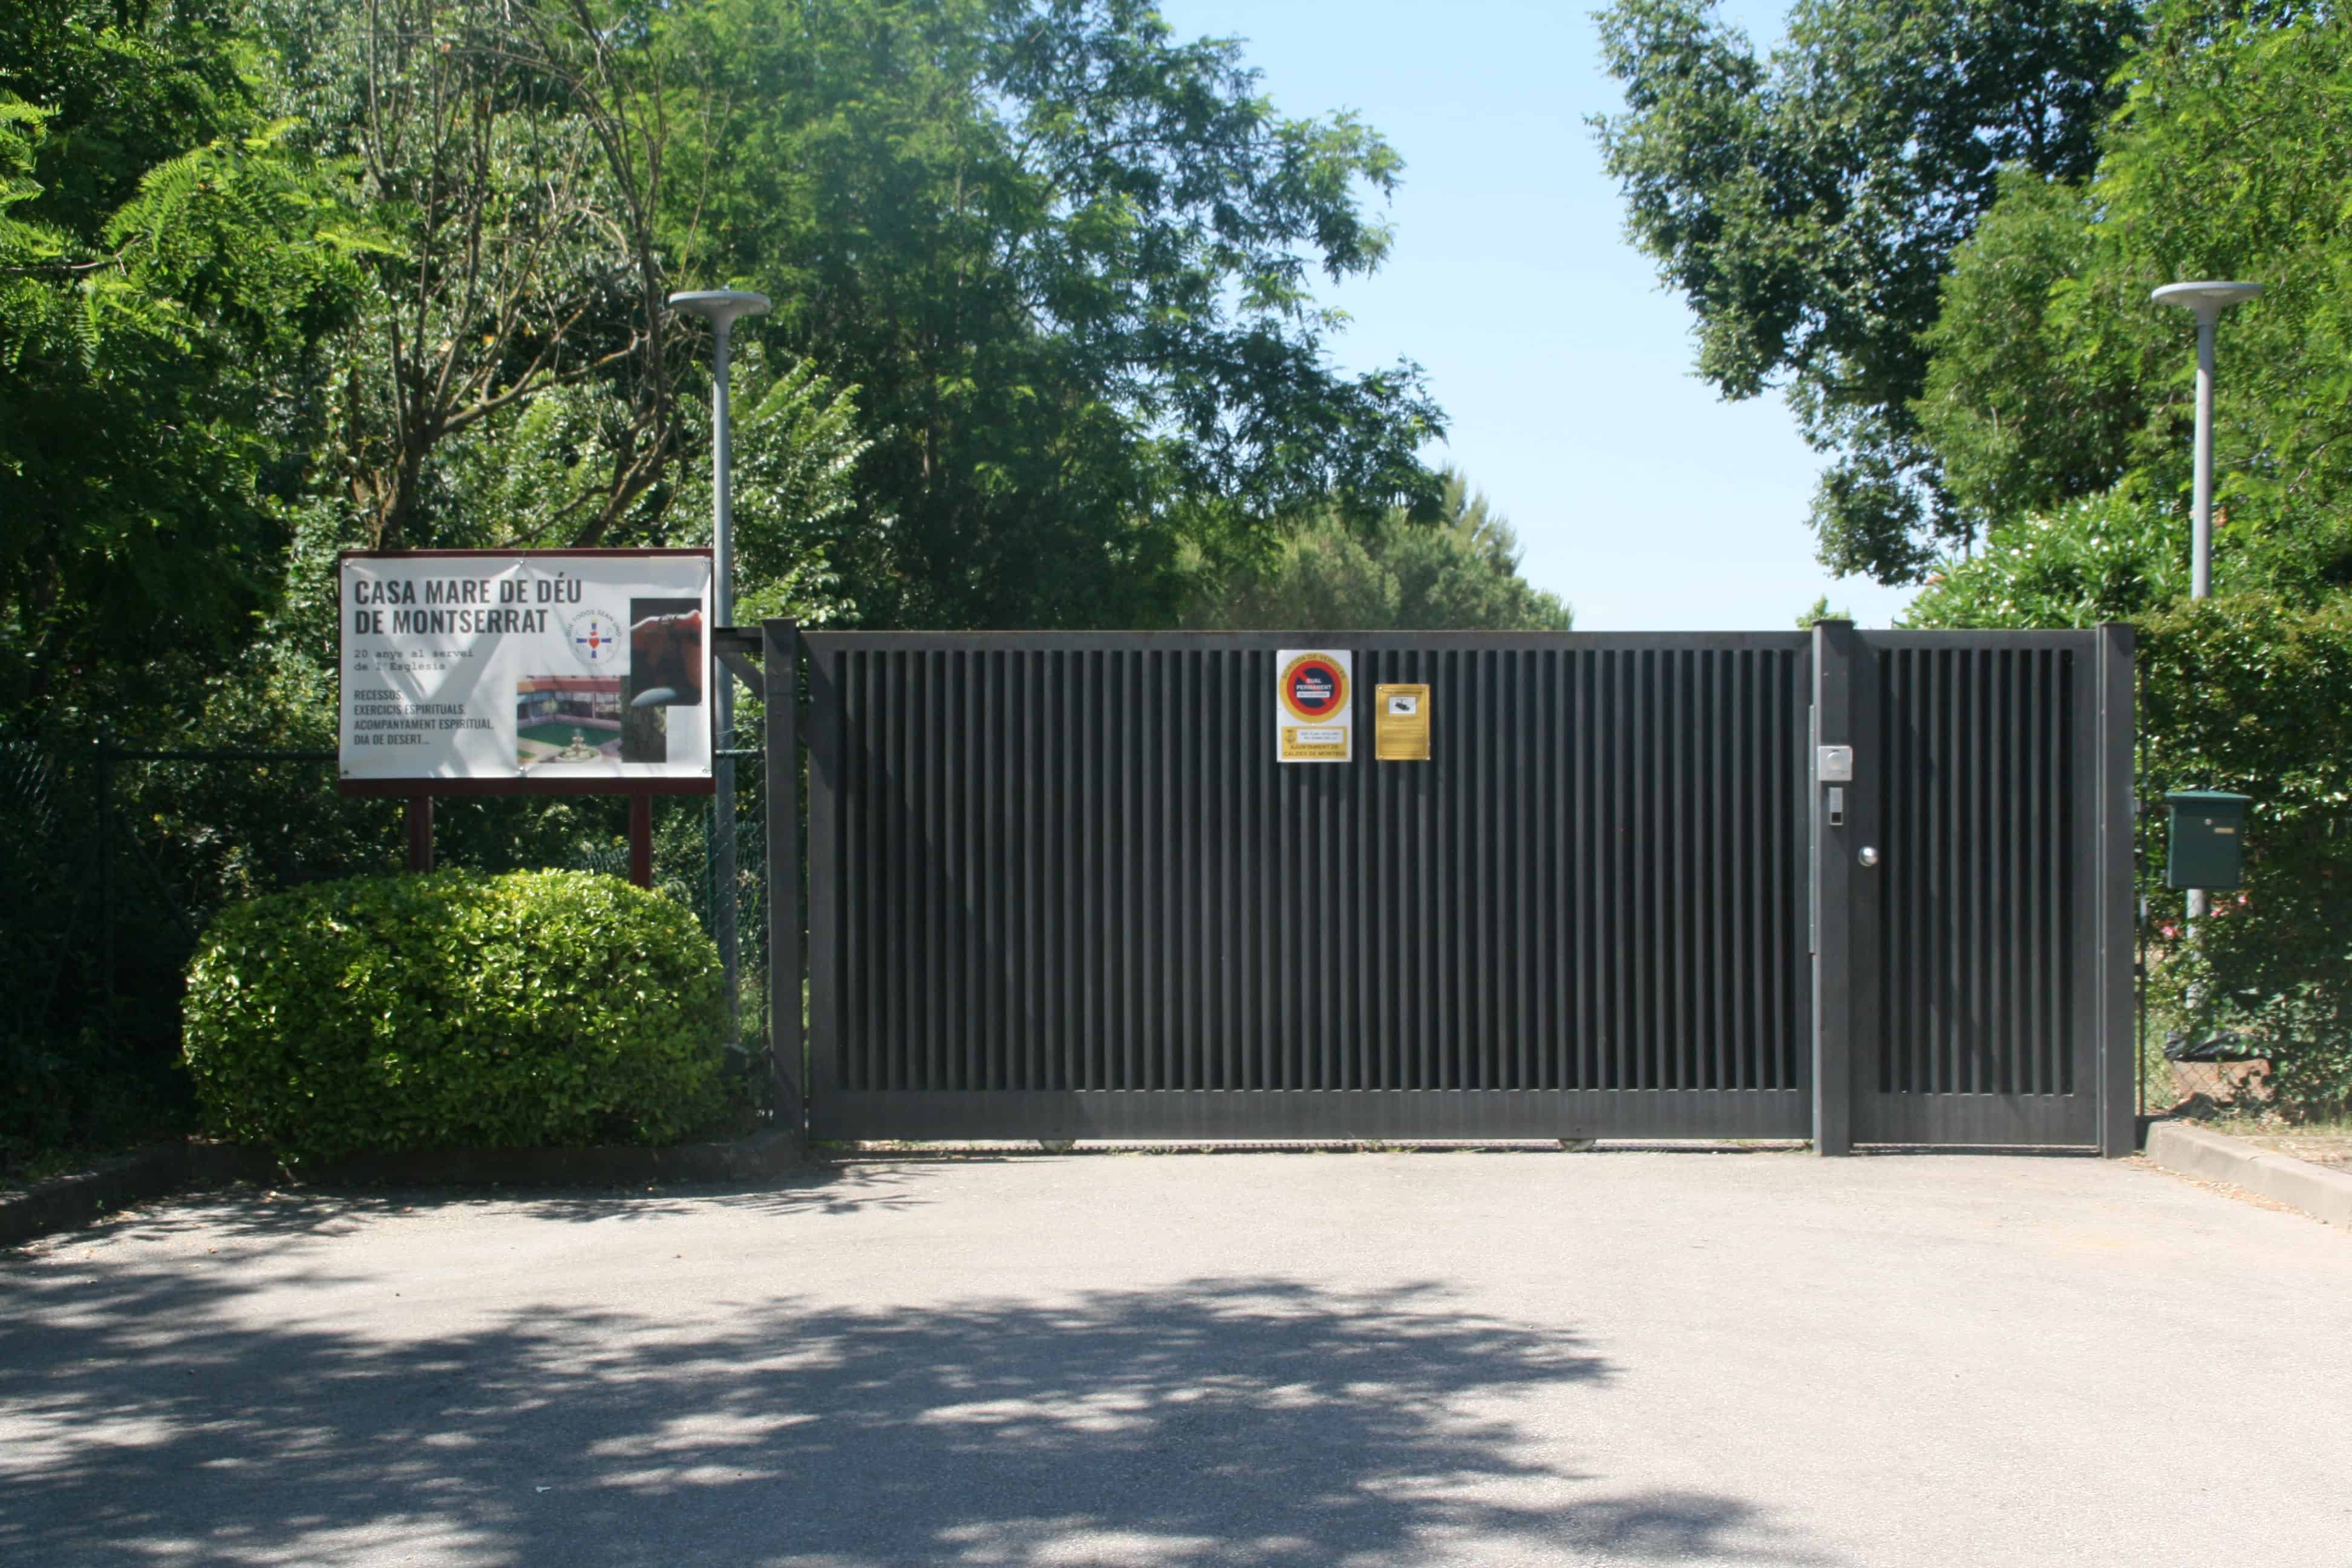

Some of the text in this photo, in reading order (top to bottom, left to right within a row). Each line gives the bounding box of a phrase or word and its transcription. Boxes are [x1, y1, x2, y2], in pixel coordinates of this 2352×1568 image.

[354, 572, 581, 605] CASA MARE DE DÉU
[572, 609, 595, 621] TODOS
[355, 609, 548, 635] DE MONTSERRAT
[354, 648, 474, 660] 20 anys al servei
[354, 662, 368, 671] de
[354, 704, 402, 716] EXERCICIS
[354, 719, 436, 730] ACOMPANYAMENT
[354, 734, 370, 745] DIA
[373, 734, 385, 745] DE
